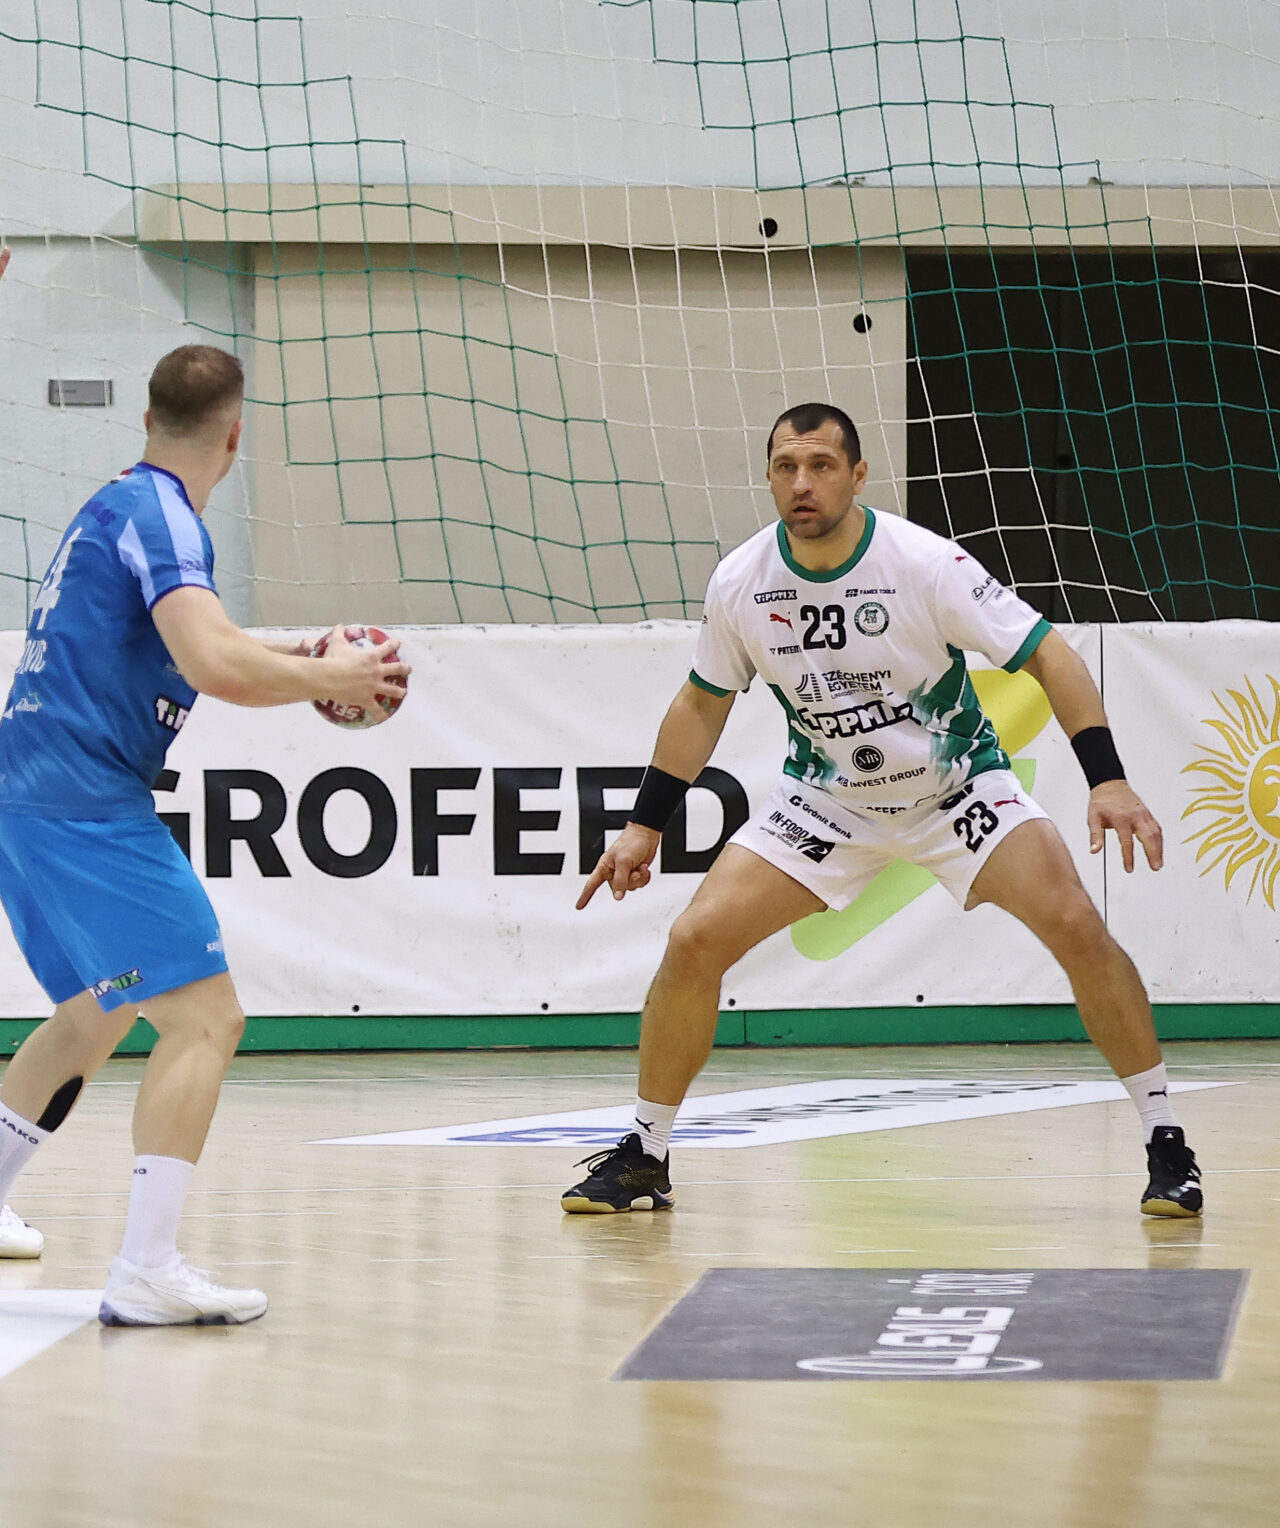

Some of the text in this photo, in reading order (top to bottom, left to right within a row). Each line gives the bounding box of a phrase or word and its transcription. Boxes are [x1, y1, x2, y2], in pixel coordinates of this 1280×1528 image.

[800, 604, 847, 650] 23
[828, 681, 882, 692] EGYETEM
[850, 777, 887, 788] INVEST
[889, 766, 927, 782] GROUP
[769, 810, 809, 839] IN-FOOD
[829, 822, 852, 839] Bank
[953, 801, 999, 854] 23
[0, 1116, 40, 1145] JAKO
[868, 1306, 1016, 1356] LEXUS
